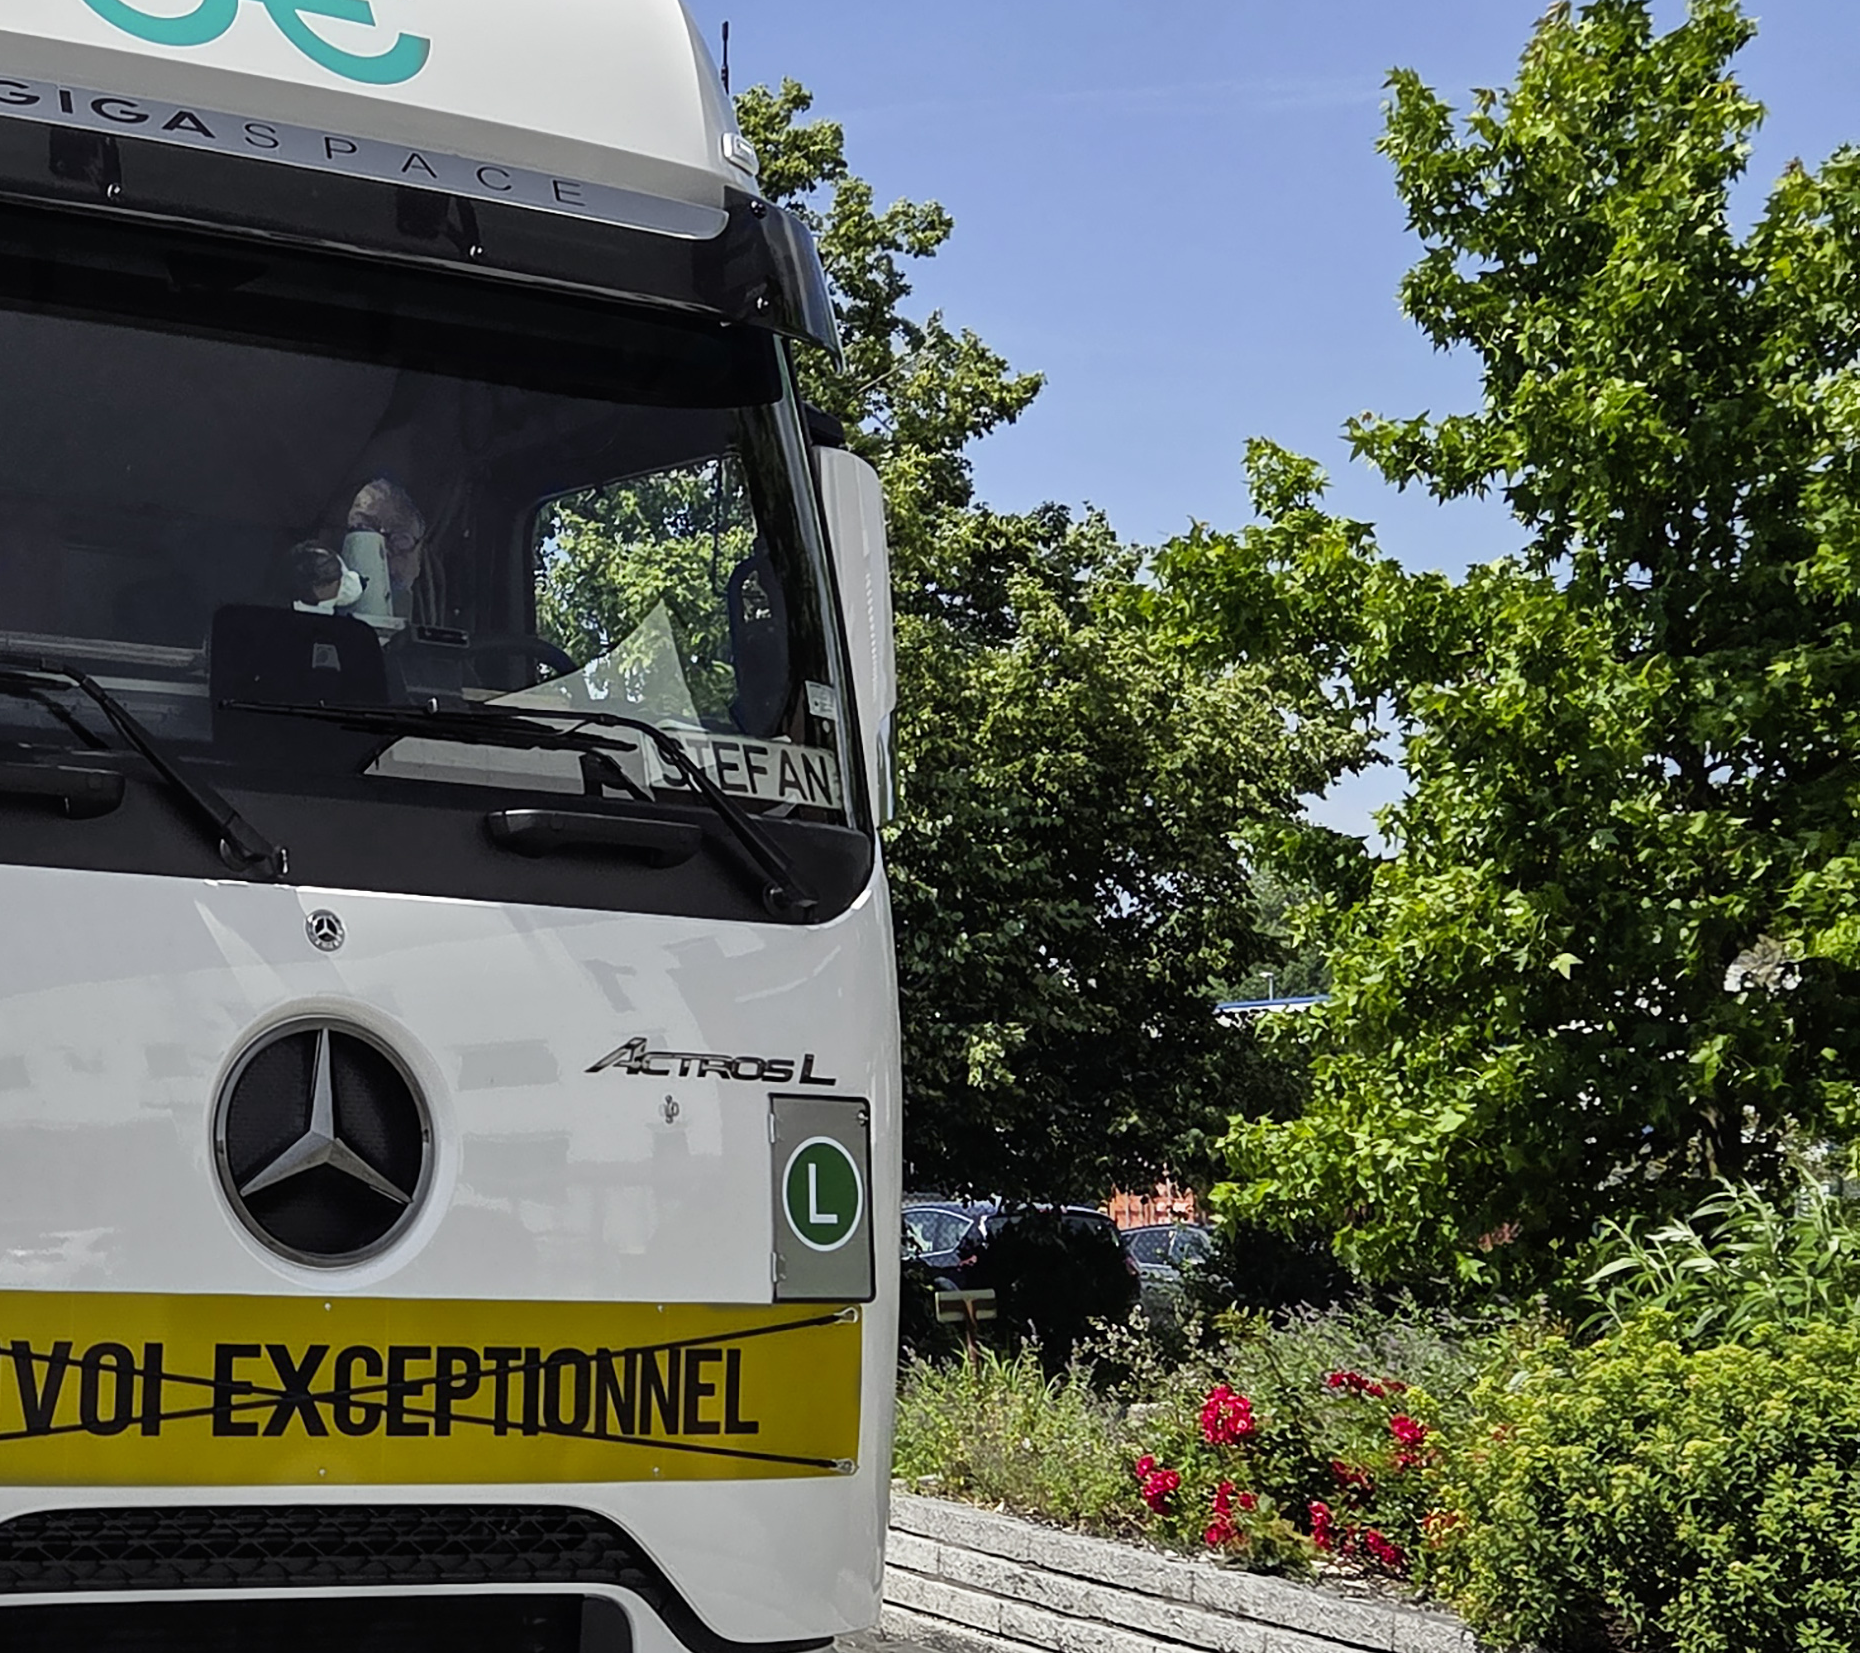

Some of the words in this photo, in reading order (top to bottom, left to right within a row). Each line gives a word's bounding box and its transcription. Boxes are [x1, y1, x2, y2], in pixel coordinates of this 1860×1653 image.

[657, 737, 833, 806] STEFAN
[798, 1053, 837, 1086] L
[807, 1162, 839, 1225] L
[212, 1342, 759, 1438] EXCEPTIONNEL
